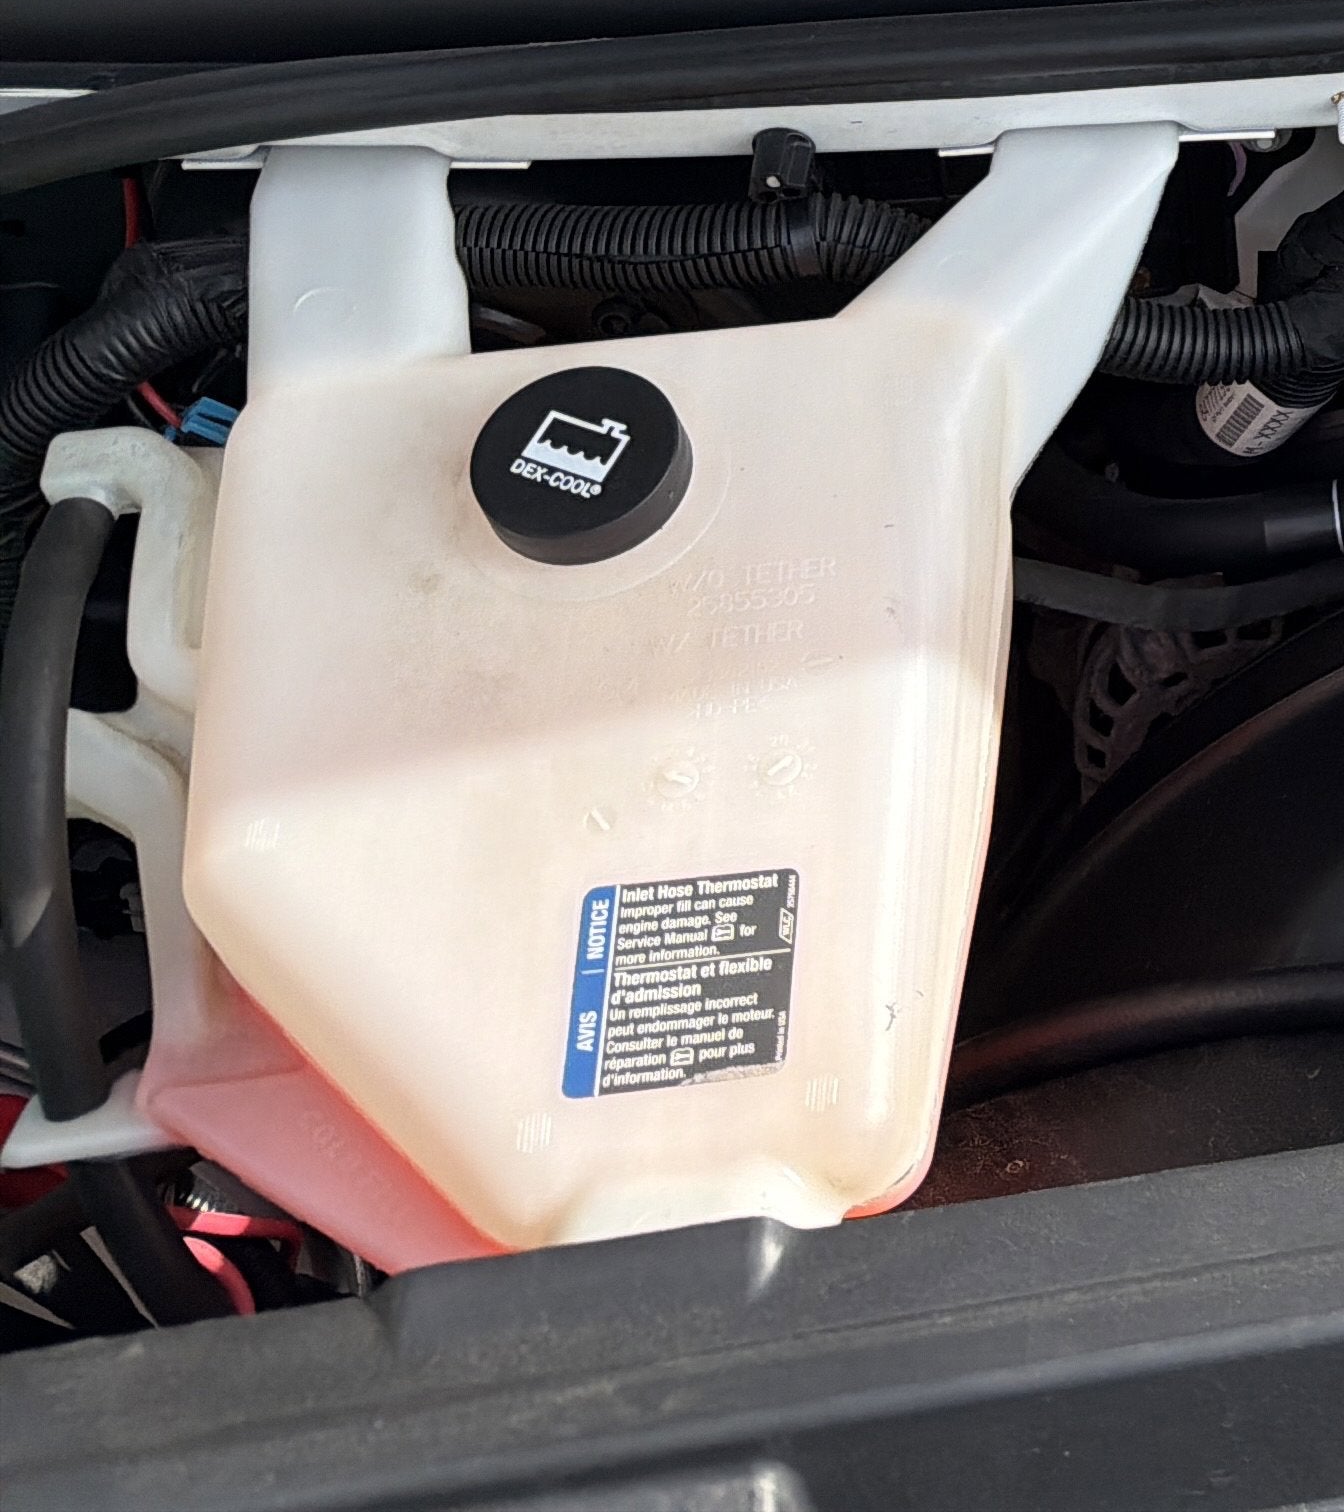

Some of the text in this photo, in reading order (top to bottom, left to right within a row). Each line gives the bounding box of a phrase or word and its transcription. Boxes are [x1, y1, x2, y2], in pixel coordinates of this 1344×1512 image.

[742, 556, 838, 588] TETHER
[708, 619, 806, 651] TETHER
[622, 873, 779, 904] Inlet Hose Thermostat
[620, 894, 755, 919] Improper fill can cause
[586, 899, 610, 960] NOTICE
[616, 923, 758, 951] Service Manual for
[618, 911, 738, 936] engine damage. See
[615, 945, 721, 966] more information.
[613, 957, 773, 988] Thermostat et flexible
[609, 992, 759, 1022] Un remplissage incorrect
[611, 983, 703, 1006] d'admission
[576, 1009, 599, 1052] AVIS
[607, 1008, 775, 1039] peut endommager le moteur.
[606, 1026, 744, 1054] Consulter le manuel de
[604, 1042, 756, 1071] réparation pour plus
[602, 1067, 687, 1088] d'information.
